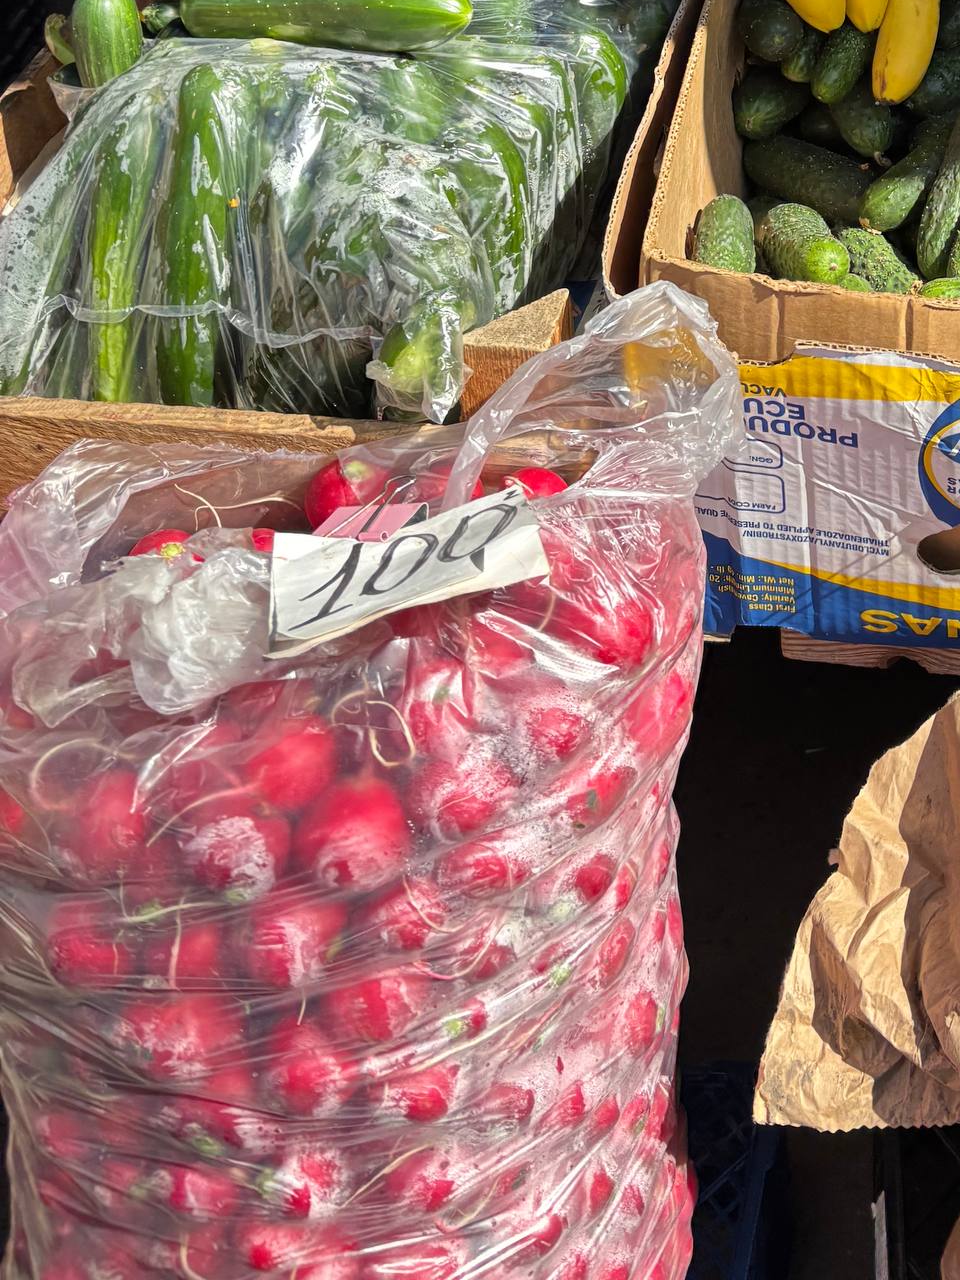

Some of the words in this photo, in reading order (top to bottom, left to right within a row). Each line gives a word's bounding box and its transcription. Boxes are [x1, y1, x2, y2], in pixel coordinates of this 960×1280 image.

[743, 398, 806, 421] ECU
[743, 415, 859, 449] PRODU
[694, 504, 719, 518] QUAL
[752, 501, 776, 511] FARM
[763, 522, 775, 531] TO
[776, 523, 815, 535] APPLIED
[815, 528, 889, 547] THIABENDAZOLE
[777, 576, 795, 586] Net
[748, 584, 796, 595] Minimum
[762, 593, 796, 604] Variety:
[748, 602, 773, 612] Class
[776, 603, 796, 613] First
